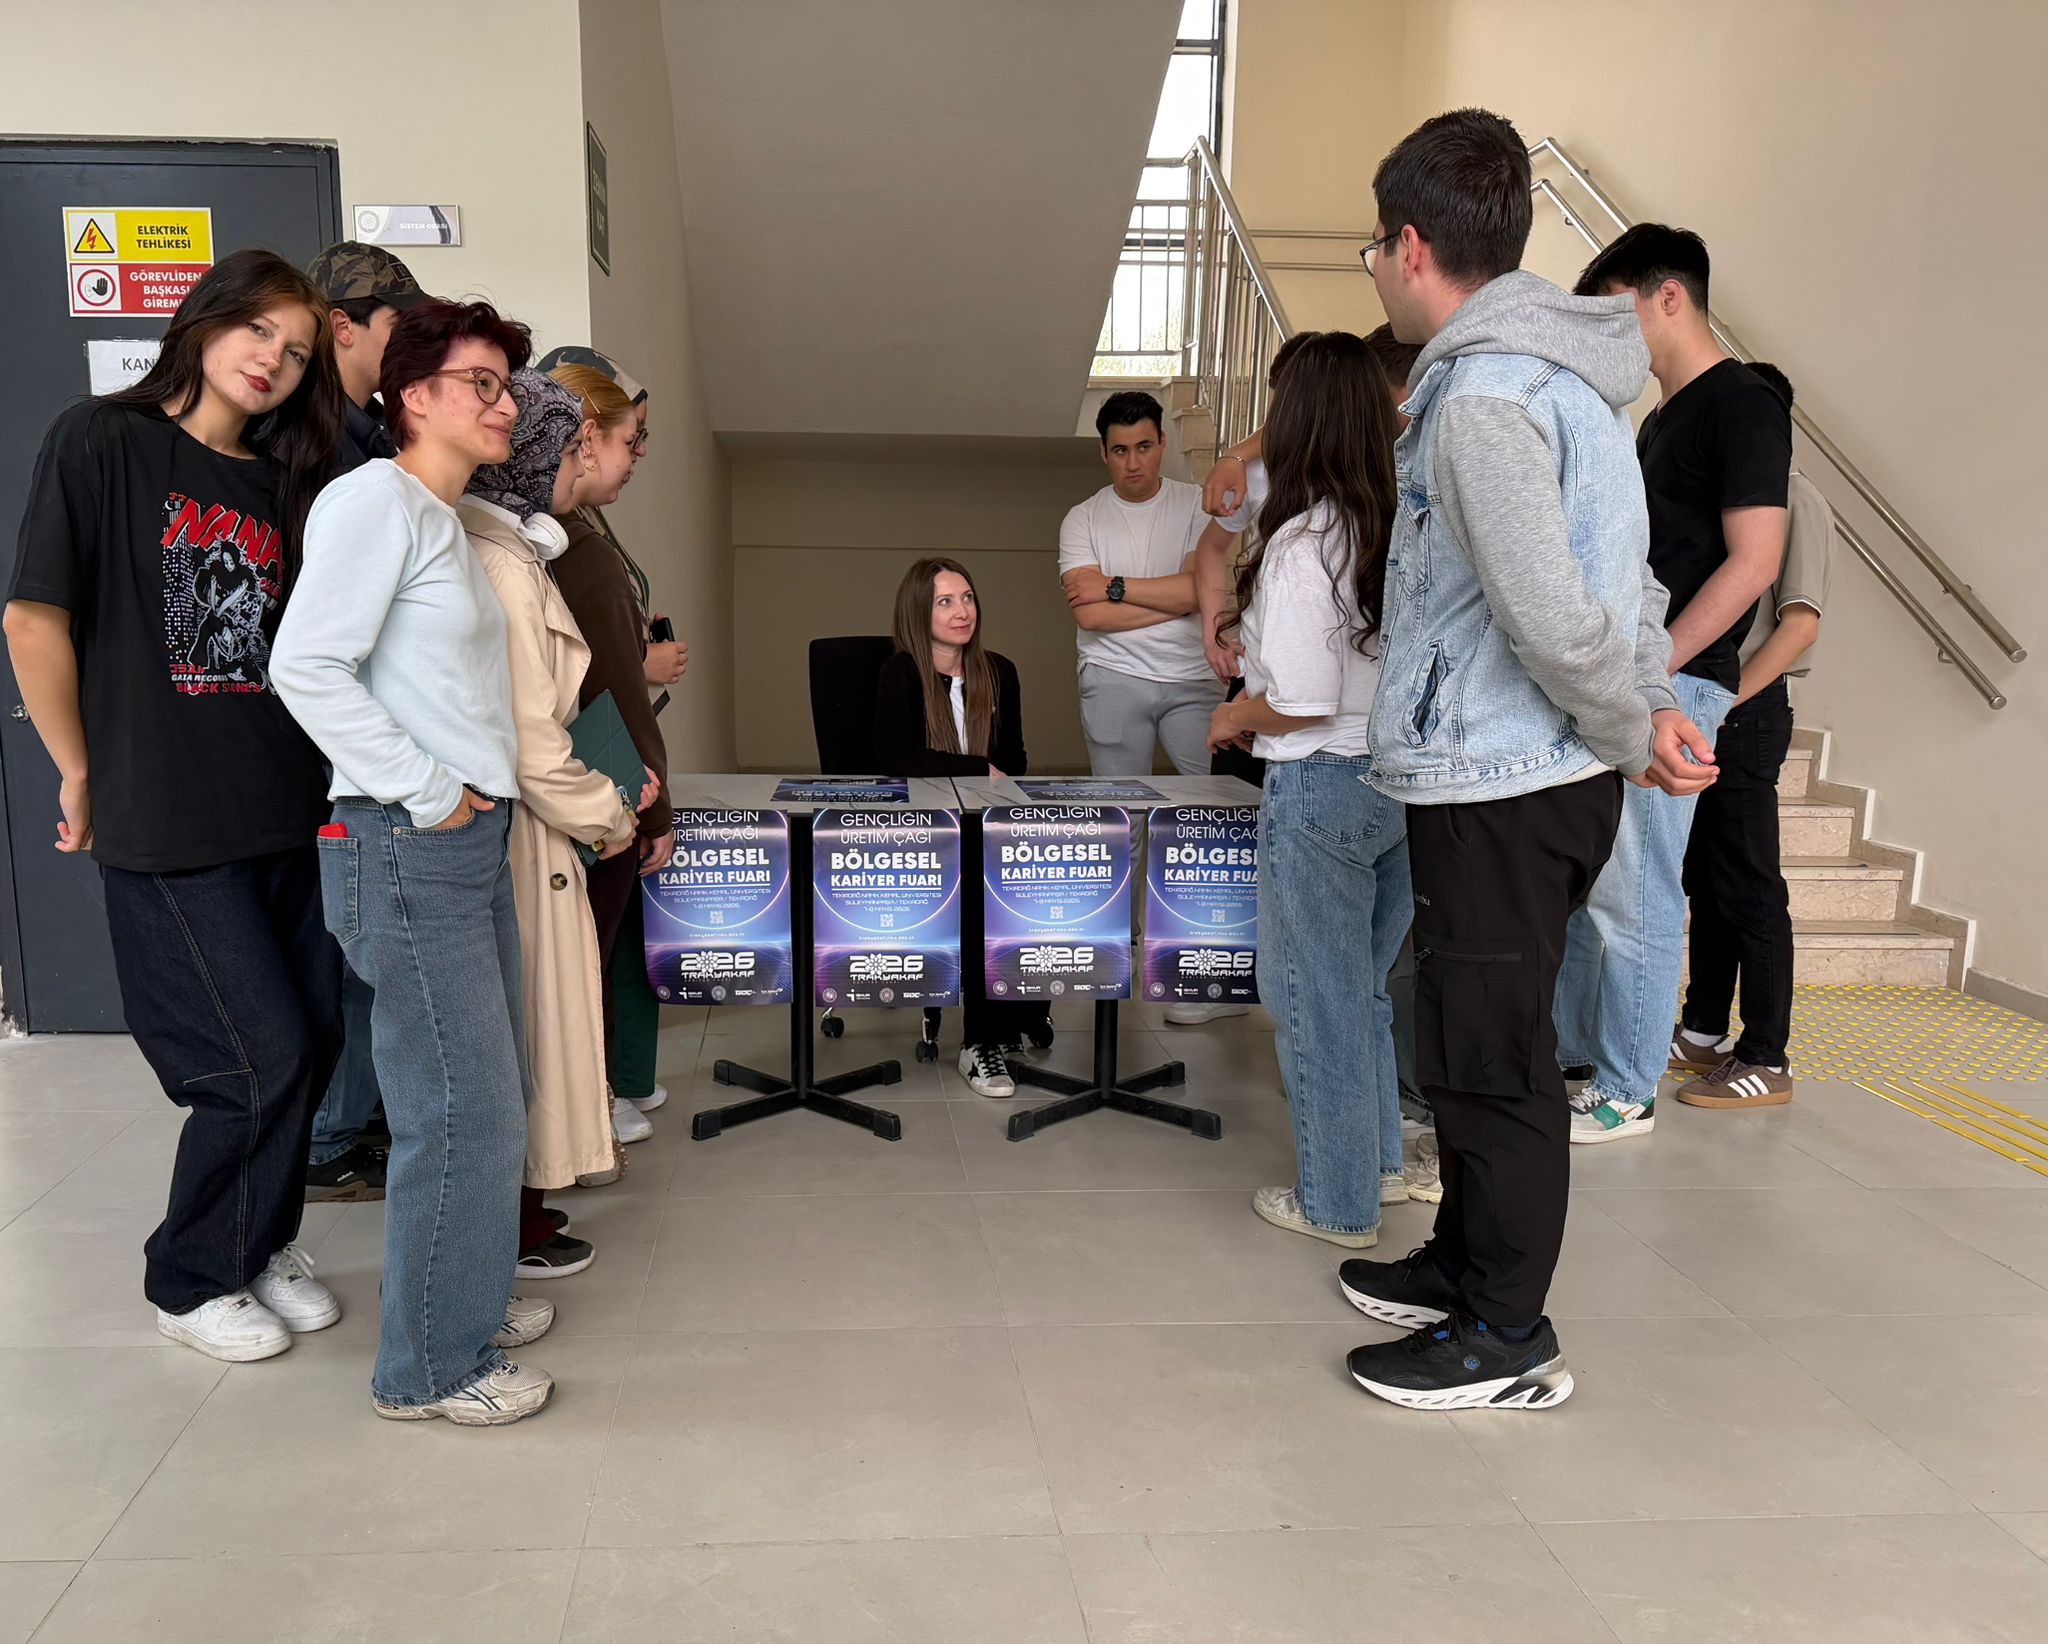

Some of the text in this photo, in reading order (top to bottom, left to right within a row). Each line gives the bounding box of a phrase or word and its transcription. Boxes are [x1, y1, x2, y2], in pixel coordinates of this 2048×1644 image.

[137, 224, 189, 235] ELEKTRİK
[136, 237, 191, 249] TEHLİKESİ
[130, 269, 202, 282] GÖREVLİDEN
[143, 285, 190, 298] BAŞKASI
[143, 296, 184, 308] GİREM
[122, 357, 158, 371] KAN
[160, 498, 282, 576] NANA
[171, 674, 193, 682] GAIA
[840, 812, 932, 829] GENÇLİĞİN
[1176, 808, 1259, 824] GENÇLİĞİ
[720, 825, 759, 843] ÇAĞI
[840, 829, 931, 846] ÜRETİM ÇAĞI
[1010, 821, 1101, 839] ÜRETİM ÇAĞI
[1176, 824, 1225, 839] ÜRETİM
[663, 846, 769, 867] ÖLGESEL
[831, 848, 941, 869] BÖLGESEL
[1001, 841, 1112, 862] BÖLGESEL
[1166, 843, 1257, 865] BÖLGES
[659, 869, 771, 884] KARİYER FUARI
[831, 871, 942, 887] KARİYER FUARI
[1001, 864, 1112, 880] KARİYER FUARI
[1165, 866, 1258, 882] KARİYER FUA
[681, 971, 755, 979] TRAKYAKAF
[1020, 965, 1094, 973] TRAKYAKAF
[1179, 969, 1252, 977] TRAKYAKAF
[850, 973, 923, 981] TRAKYAKAF
